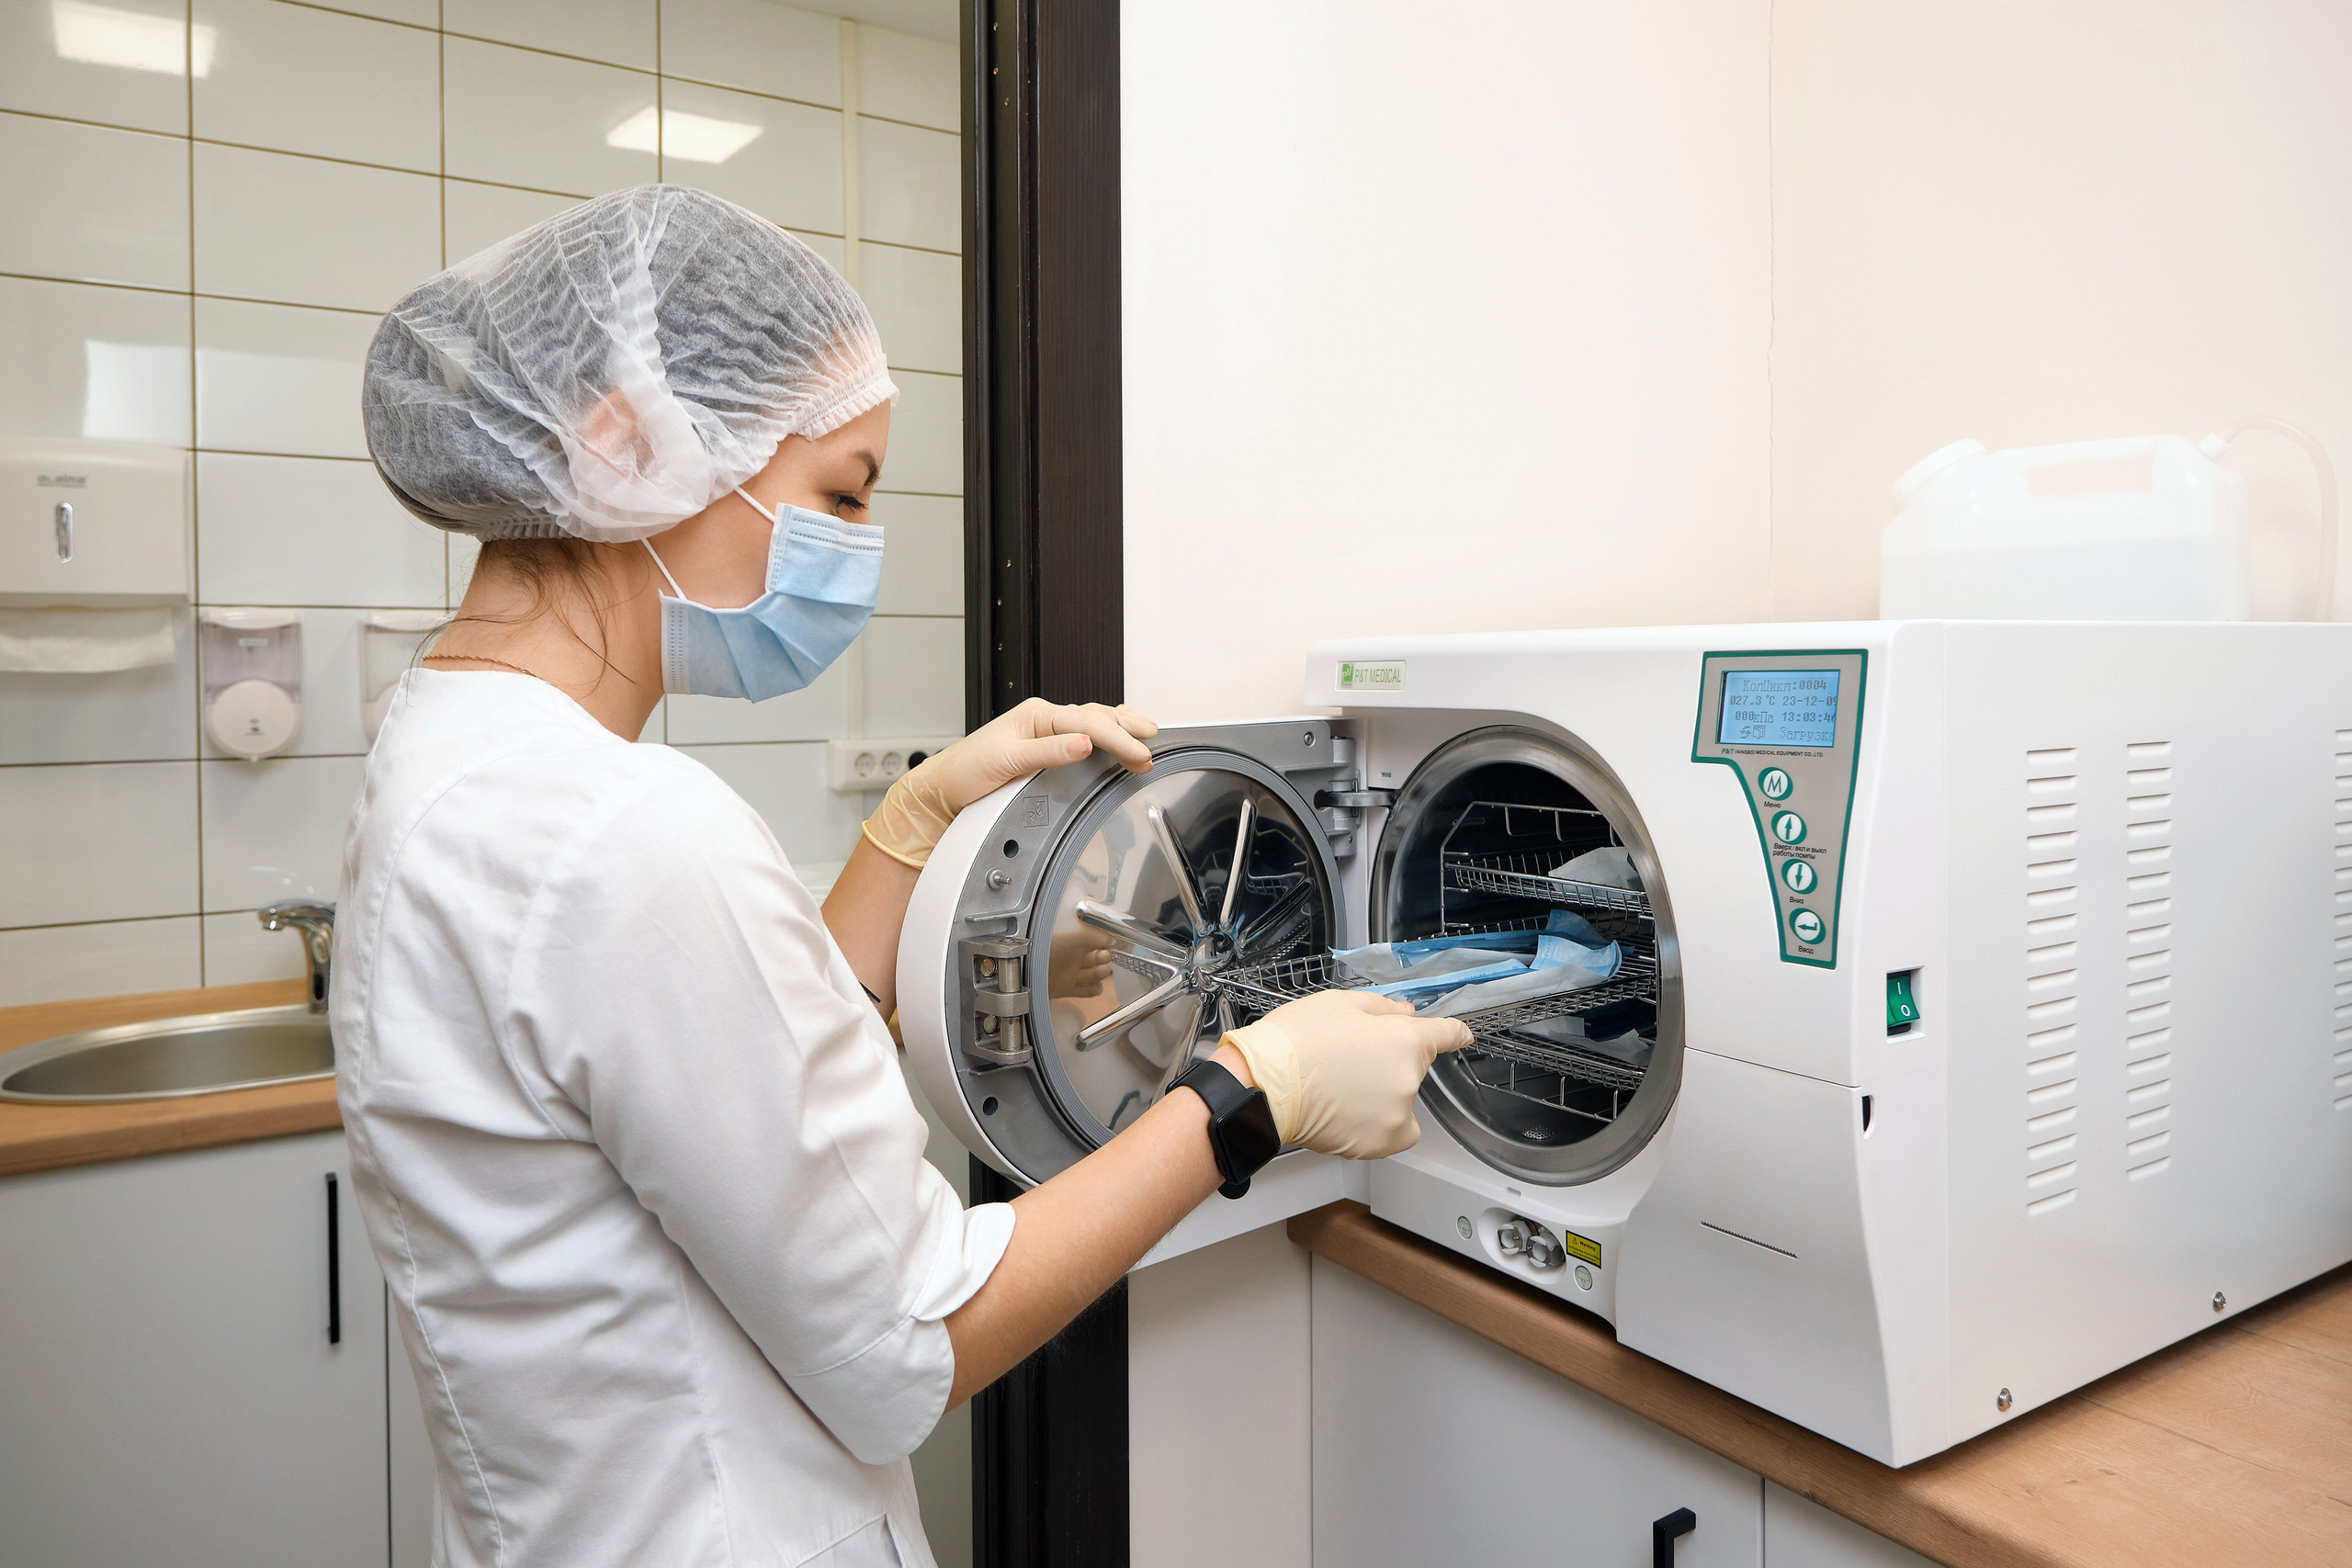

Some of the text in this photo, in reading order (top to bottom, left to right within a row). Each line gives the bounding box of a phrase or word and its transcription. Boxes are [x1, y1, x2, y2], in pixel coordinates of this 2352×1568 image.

[1354, 669, 1401, 682] P&T MEDICAL
[1789, 896, 1804, 905] Вниз
